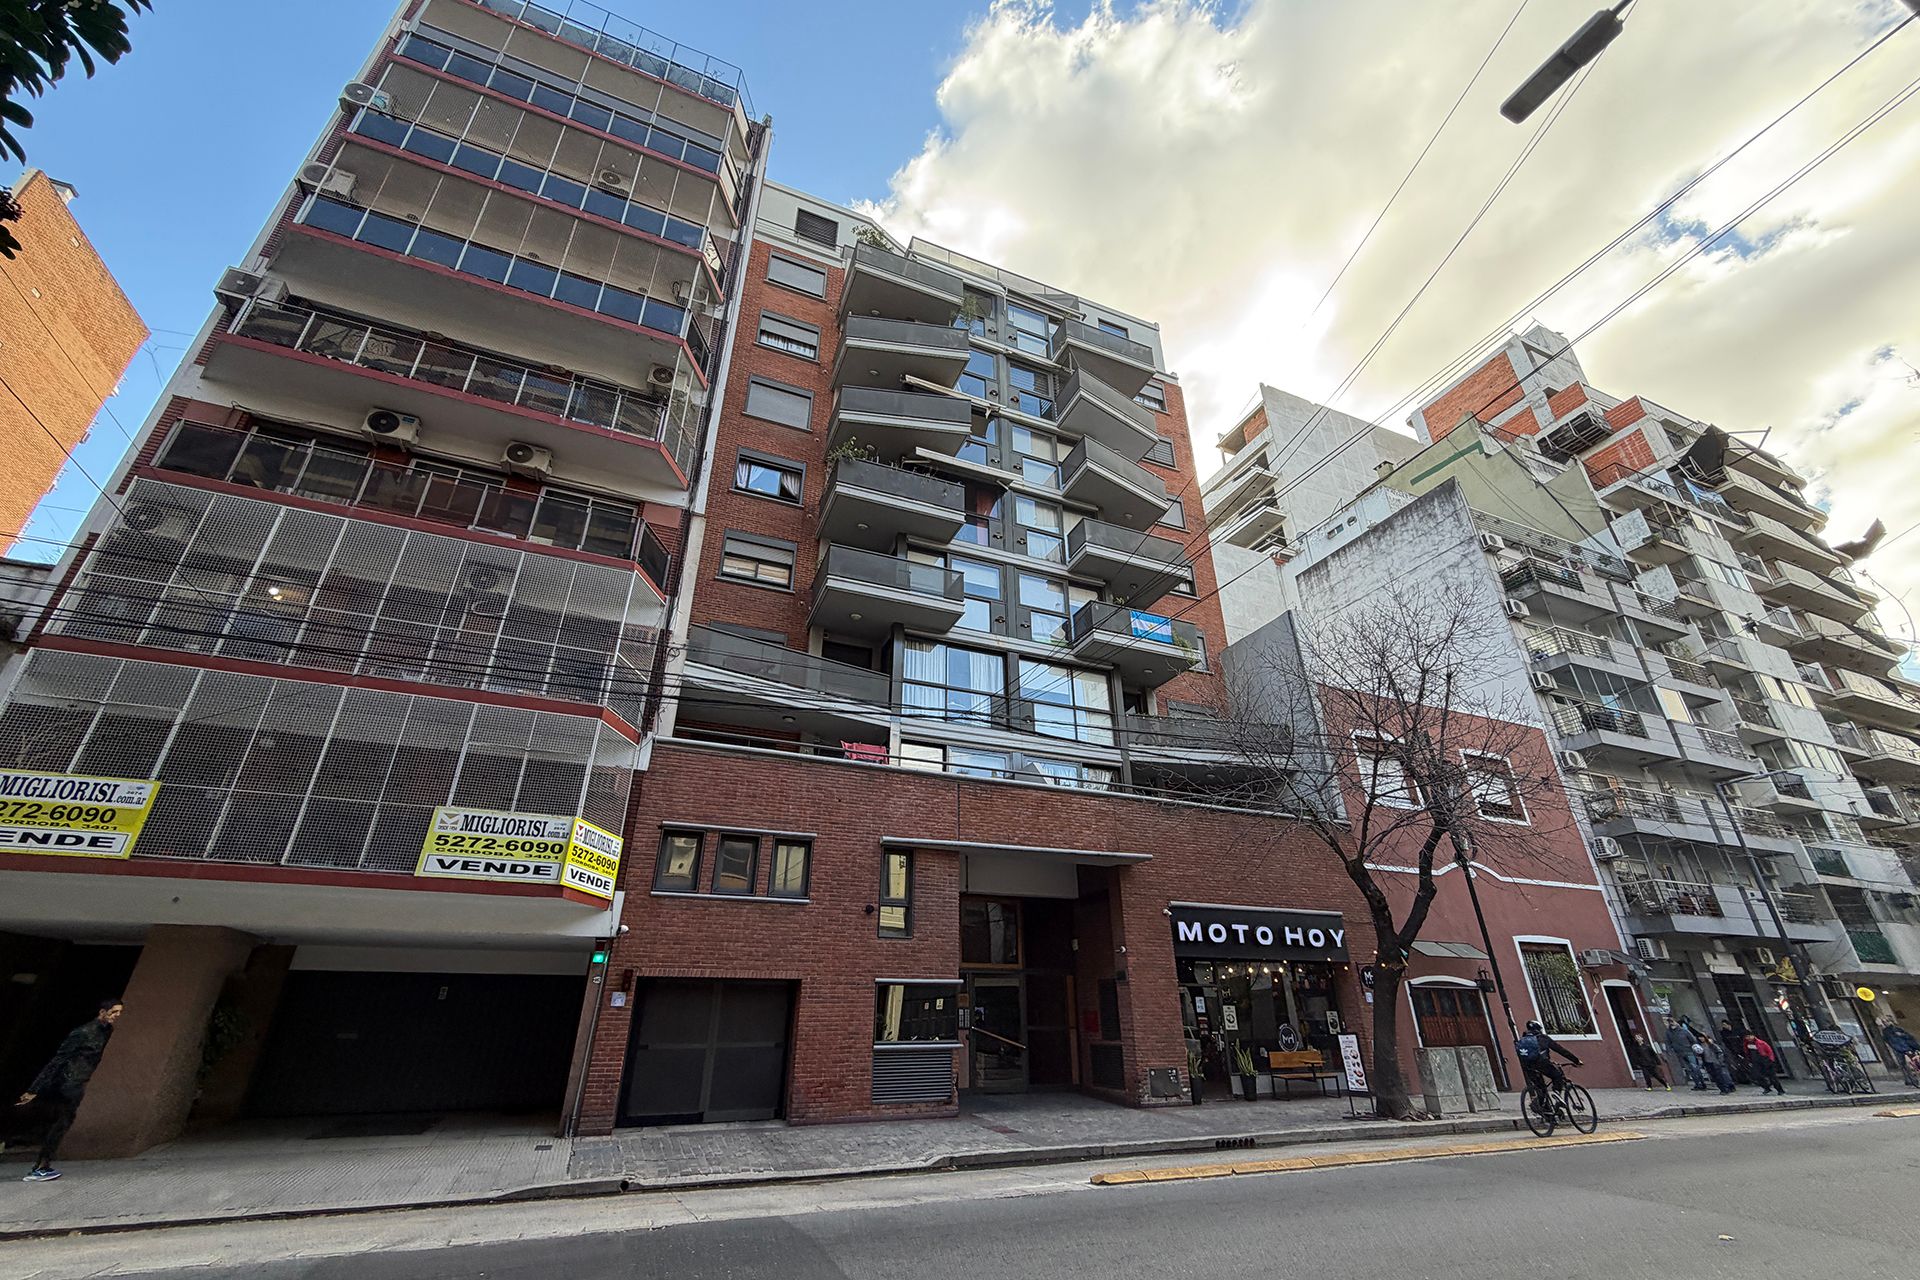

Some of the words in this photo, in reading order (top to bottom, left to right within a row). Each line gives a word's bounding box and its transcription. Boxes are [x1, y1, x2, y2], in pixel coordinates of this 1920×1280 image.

[81, 823, 118, 831] 3401
[460, 814, 549, 838] MIGLIORISI
[434, 834, 564, 855] 5272-6090
[435, 847, 515, 858] CORDOBA
[436, 858, 553, 876] VENDE
[571, 845, 617, 872] 5272-6090
[571, 857, 599, 871] CORDOBA
[570, 868, 611, 891] VENDE
[1177, 921, 1274, 946] MOTO
[1284, 926, 1345, 948] HOY
